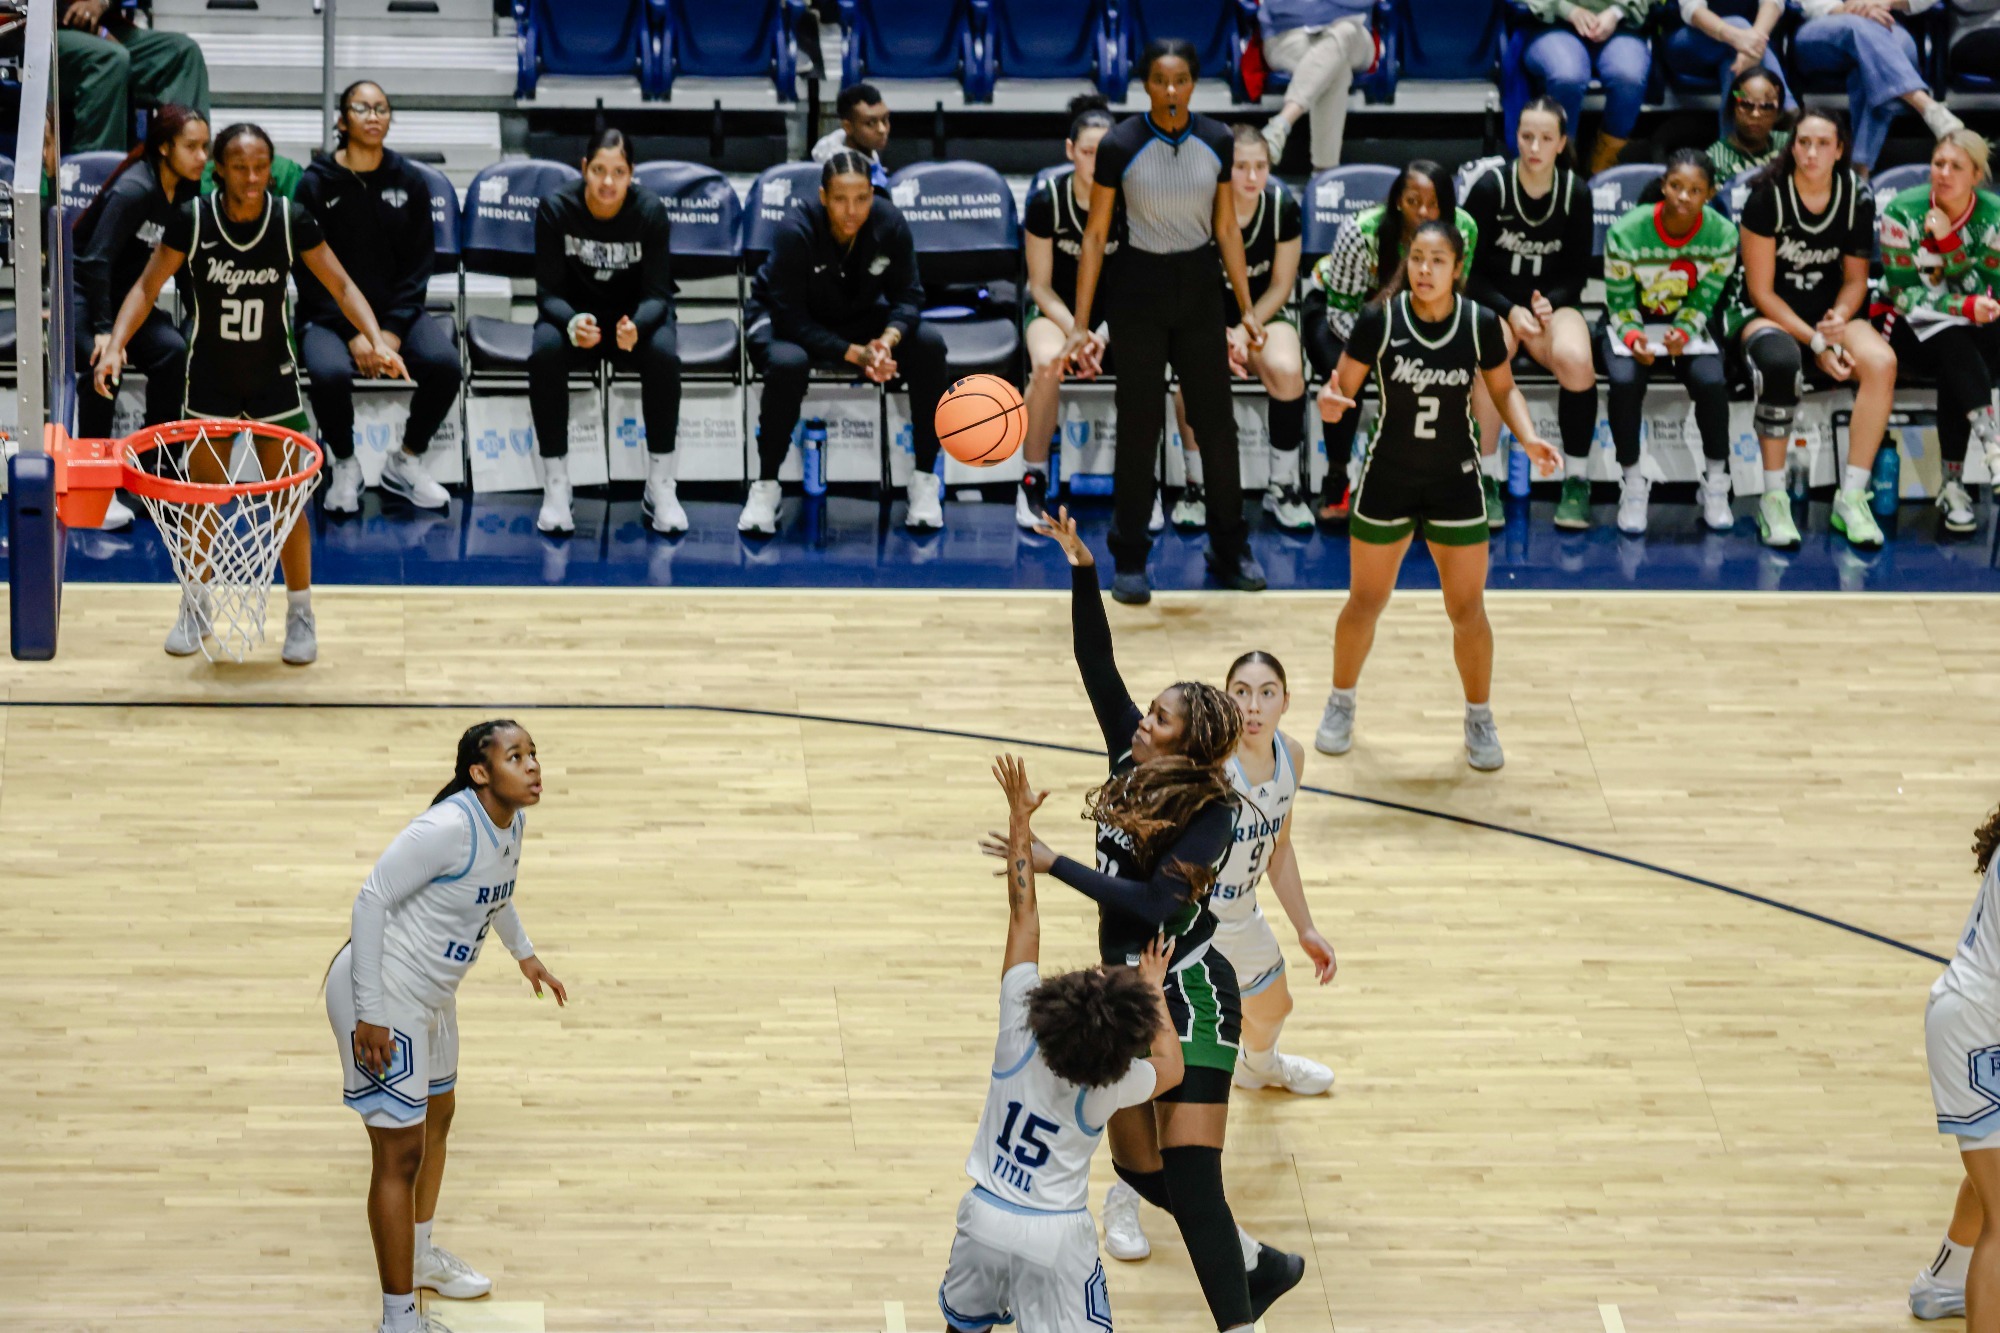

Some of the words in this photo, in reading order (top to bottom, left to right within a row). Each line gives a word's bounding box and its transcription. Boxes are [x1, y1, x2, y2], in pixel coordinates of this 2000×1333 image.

[681, 198, 720, 209] ISLAND
[921, 195, 959, 206] RHODE
[962, 193, 1001, 205] ISLAND
[478, 206, 531, 222] MEDICAL
[949, 207, 1002, 220] IMAGING
[207, 257, 279, 294] Wagner
[220, 298, 264, 341] 20
[1391, 355, 1469, 394] Wagner
[841, 418, 874, 428] Cross
[1414, 396, 1440, 439] 2
[704, 429, 736, 439] Shield
[841, 430, 874, 439] Shield
[1248, 841, 1265, 873] 9
[996, 1101, 1060, 1168] 15
[992, 1154, 1032, 1193] VITAL
